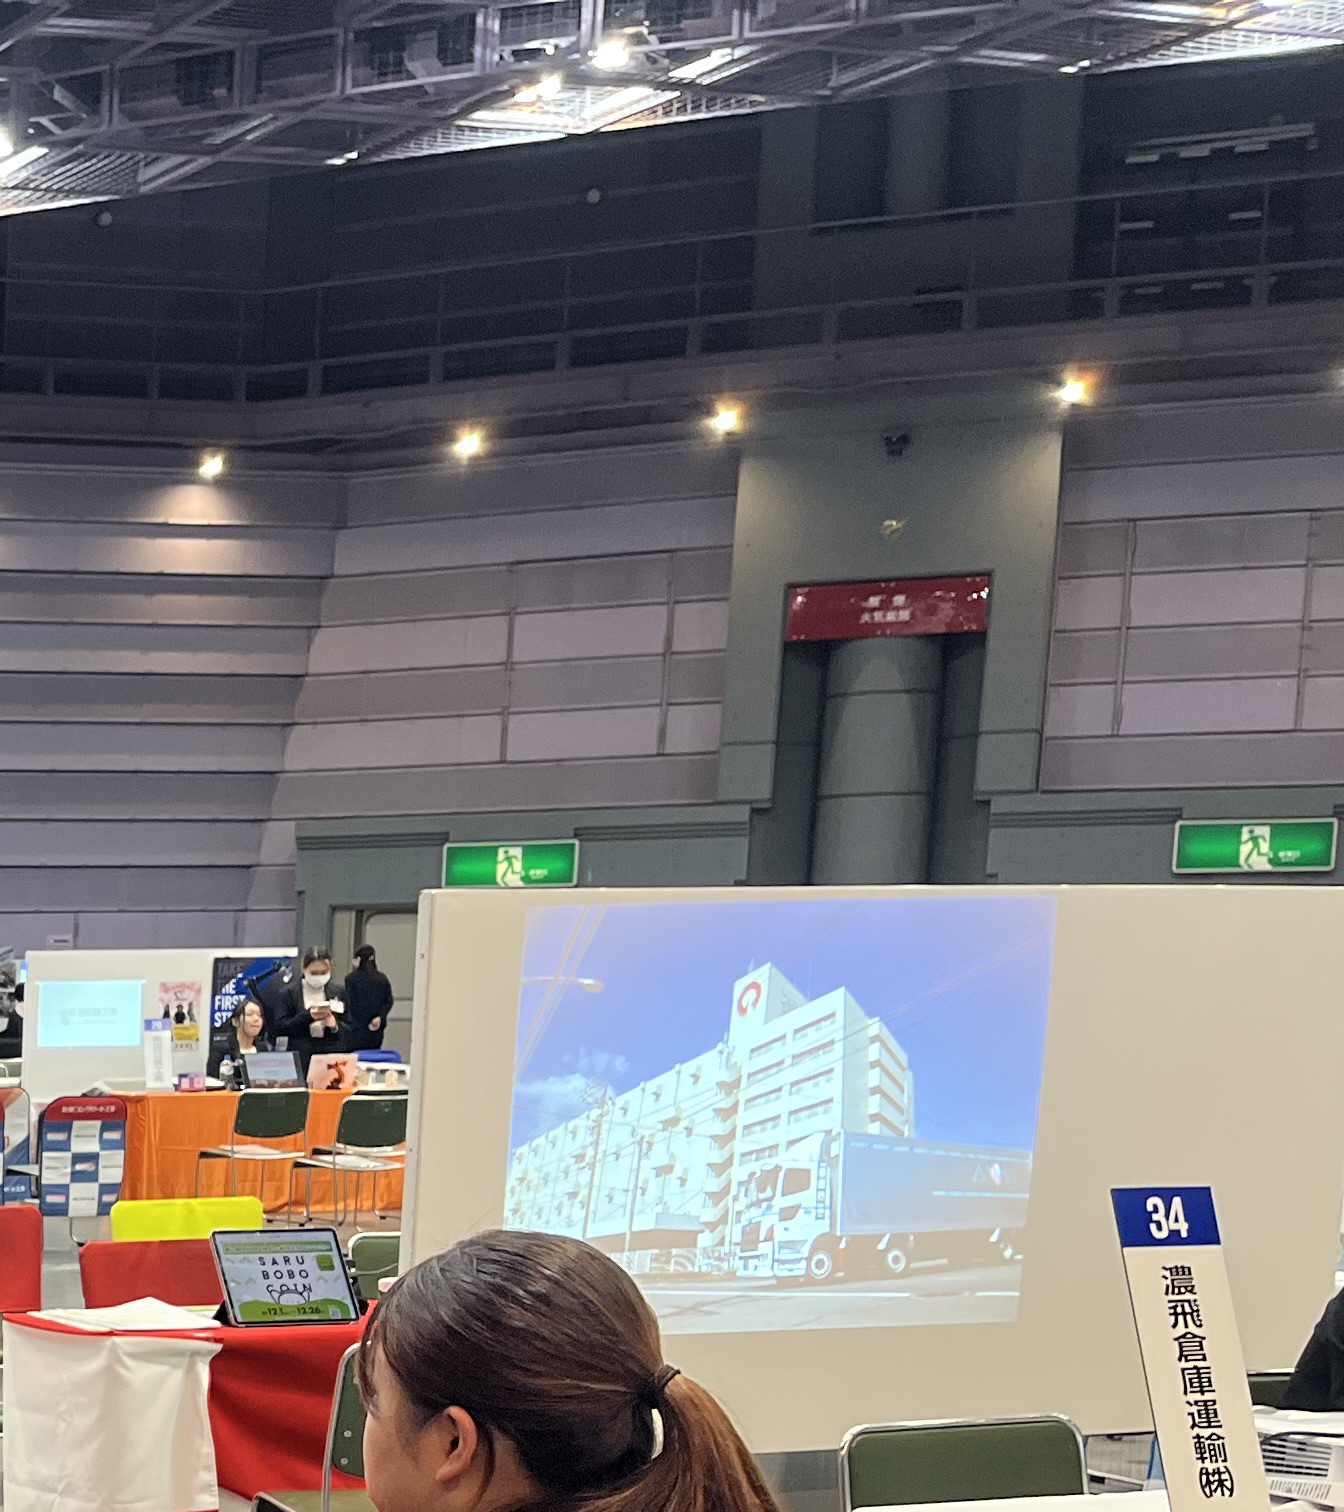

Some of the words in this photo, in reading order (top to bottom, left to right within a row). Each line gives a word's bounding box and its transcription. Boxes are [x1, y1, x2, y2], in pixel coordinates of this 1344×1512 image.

[214, 994, 246, 1011] FIRST
[1145, 1196, 1189, 1239] 34
[258, 1255, 305, 1266] SARU
[261, 1269, 309, 1280] BOBO
[266, 1283, 313, 1294] COIN
